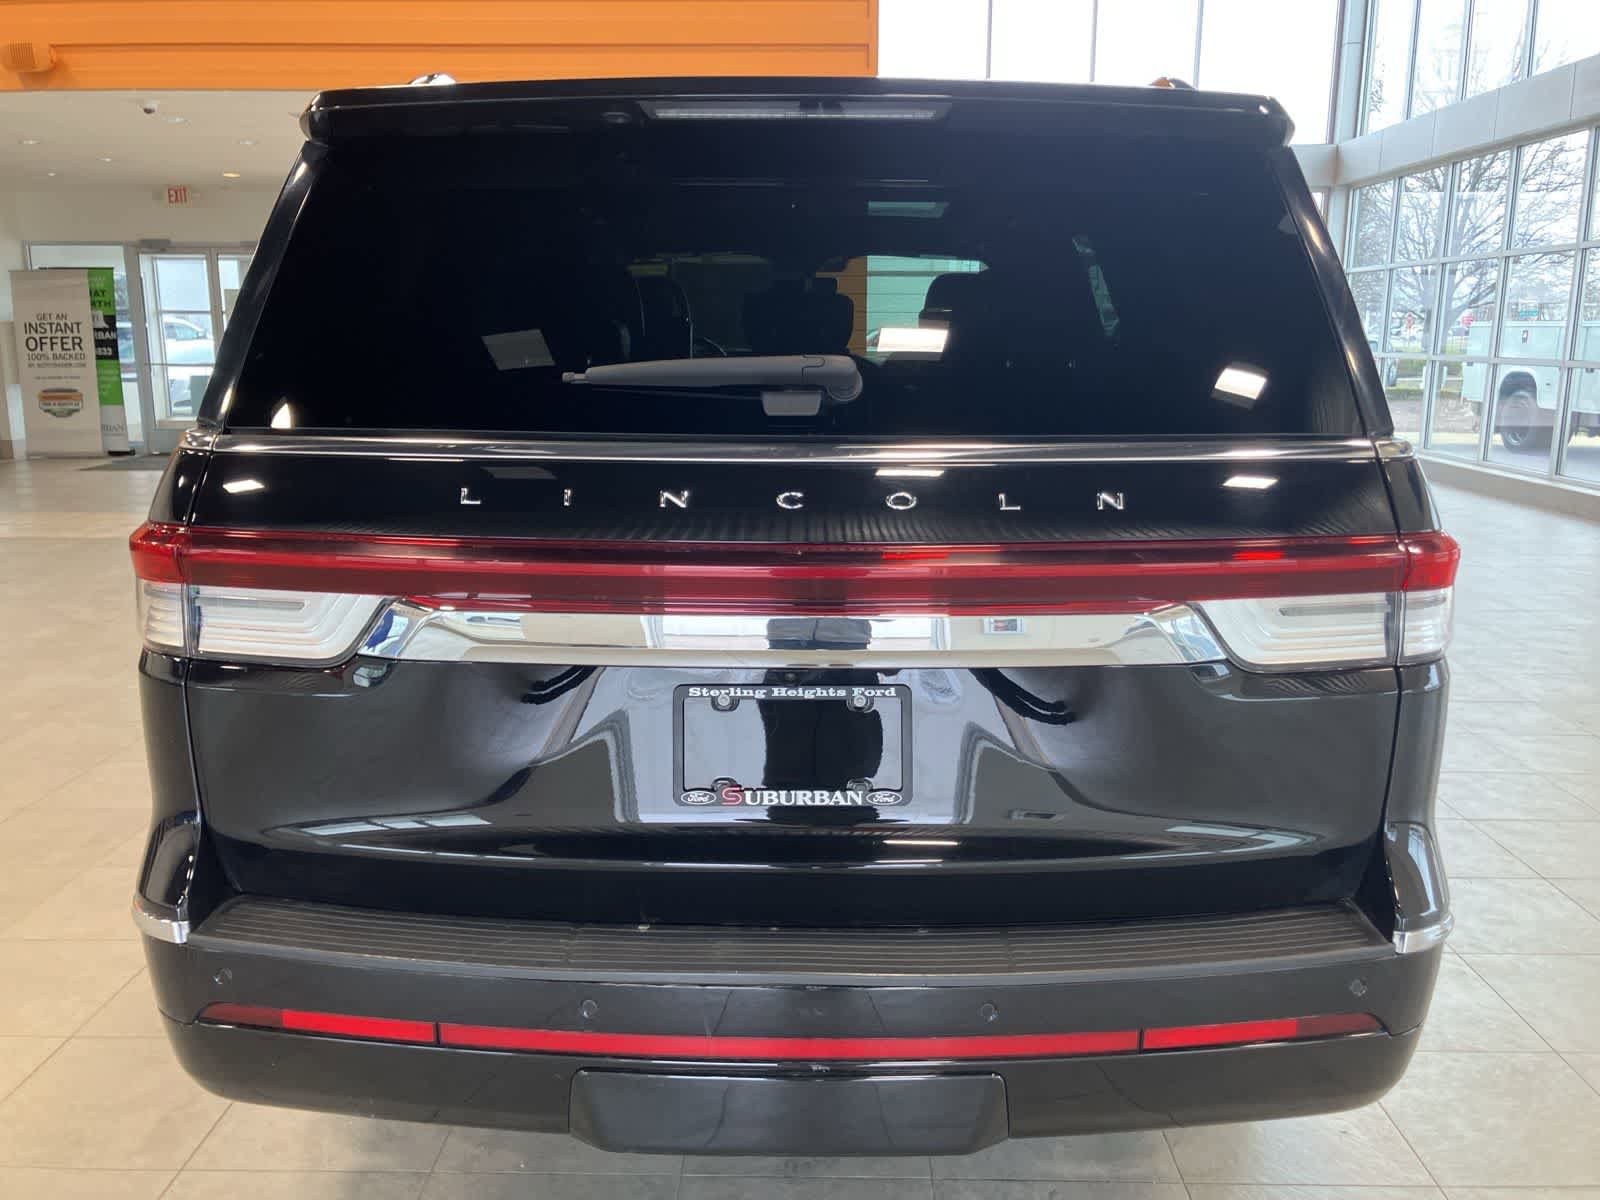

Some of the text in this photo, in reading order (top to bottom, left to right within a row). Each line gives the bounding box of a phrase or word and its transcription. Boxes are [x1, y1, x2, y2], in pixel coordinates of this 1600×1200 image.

[167, 187, 188, 204] EXIT
[36, 313, 68, 321] GET AN
[24, 321, 82, 335] INSTANT
[25, 336, 84, 352] OFFER
[27, 352, 86, 361] 100% BACKED
[460, 487, 1124, 511] LINCOLN
[688, 687, 896, 699] Sterling Heights Ford
[721, 786, 864, 806] SUBURBAN
